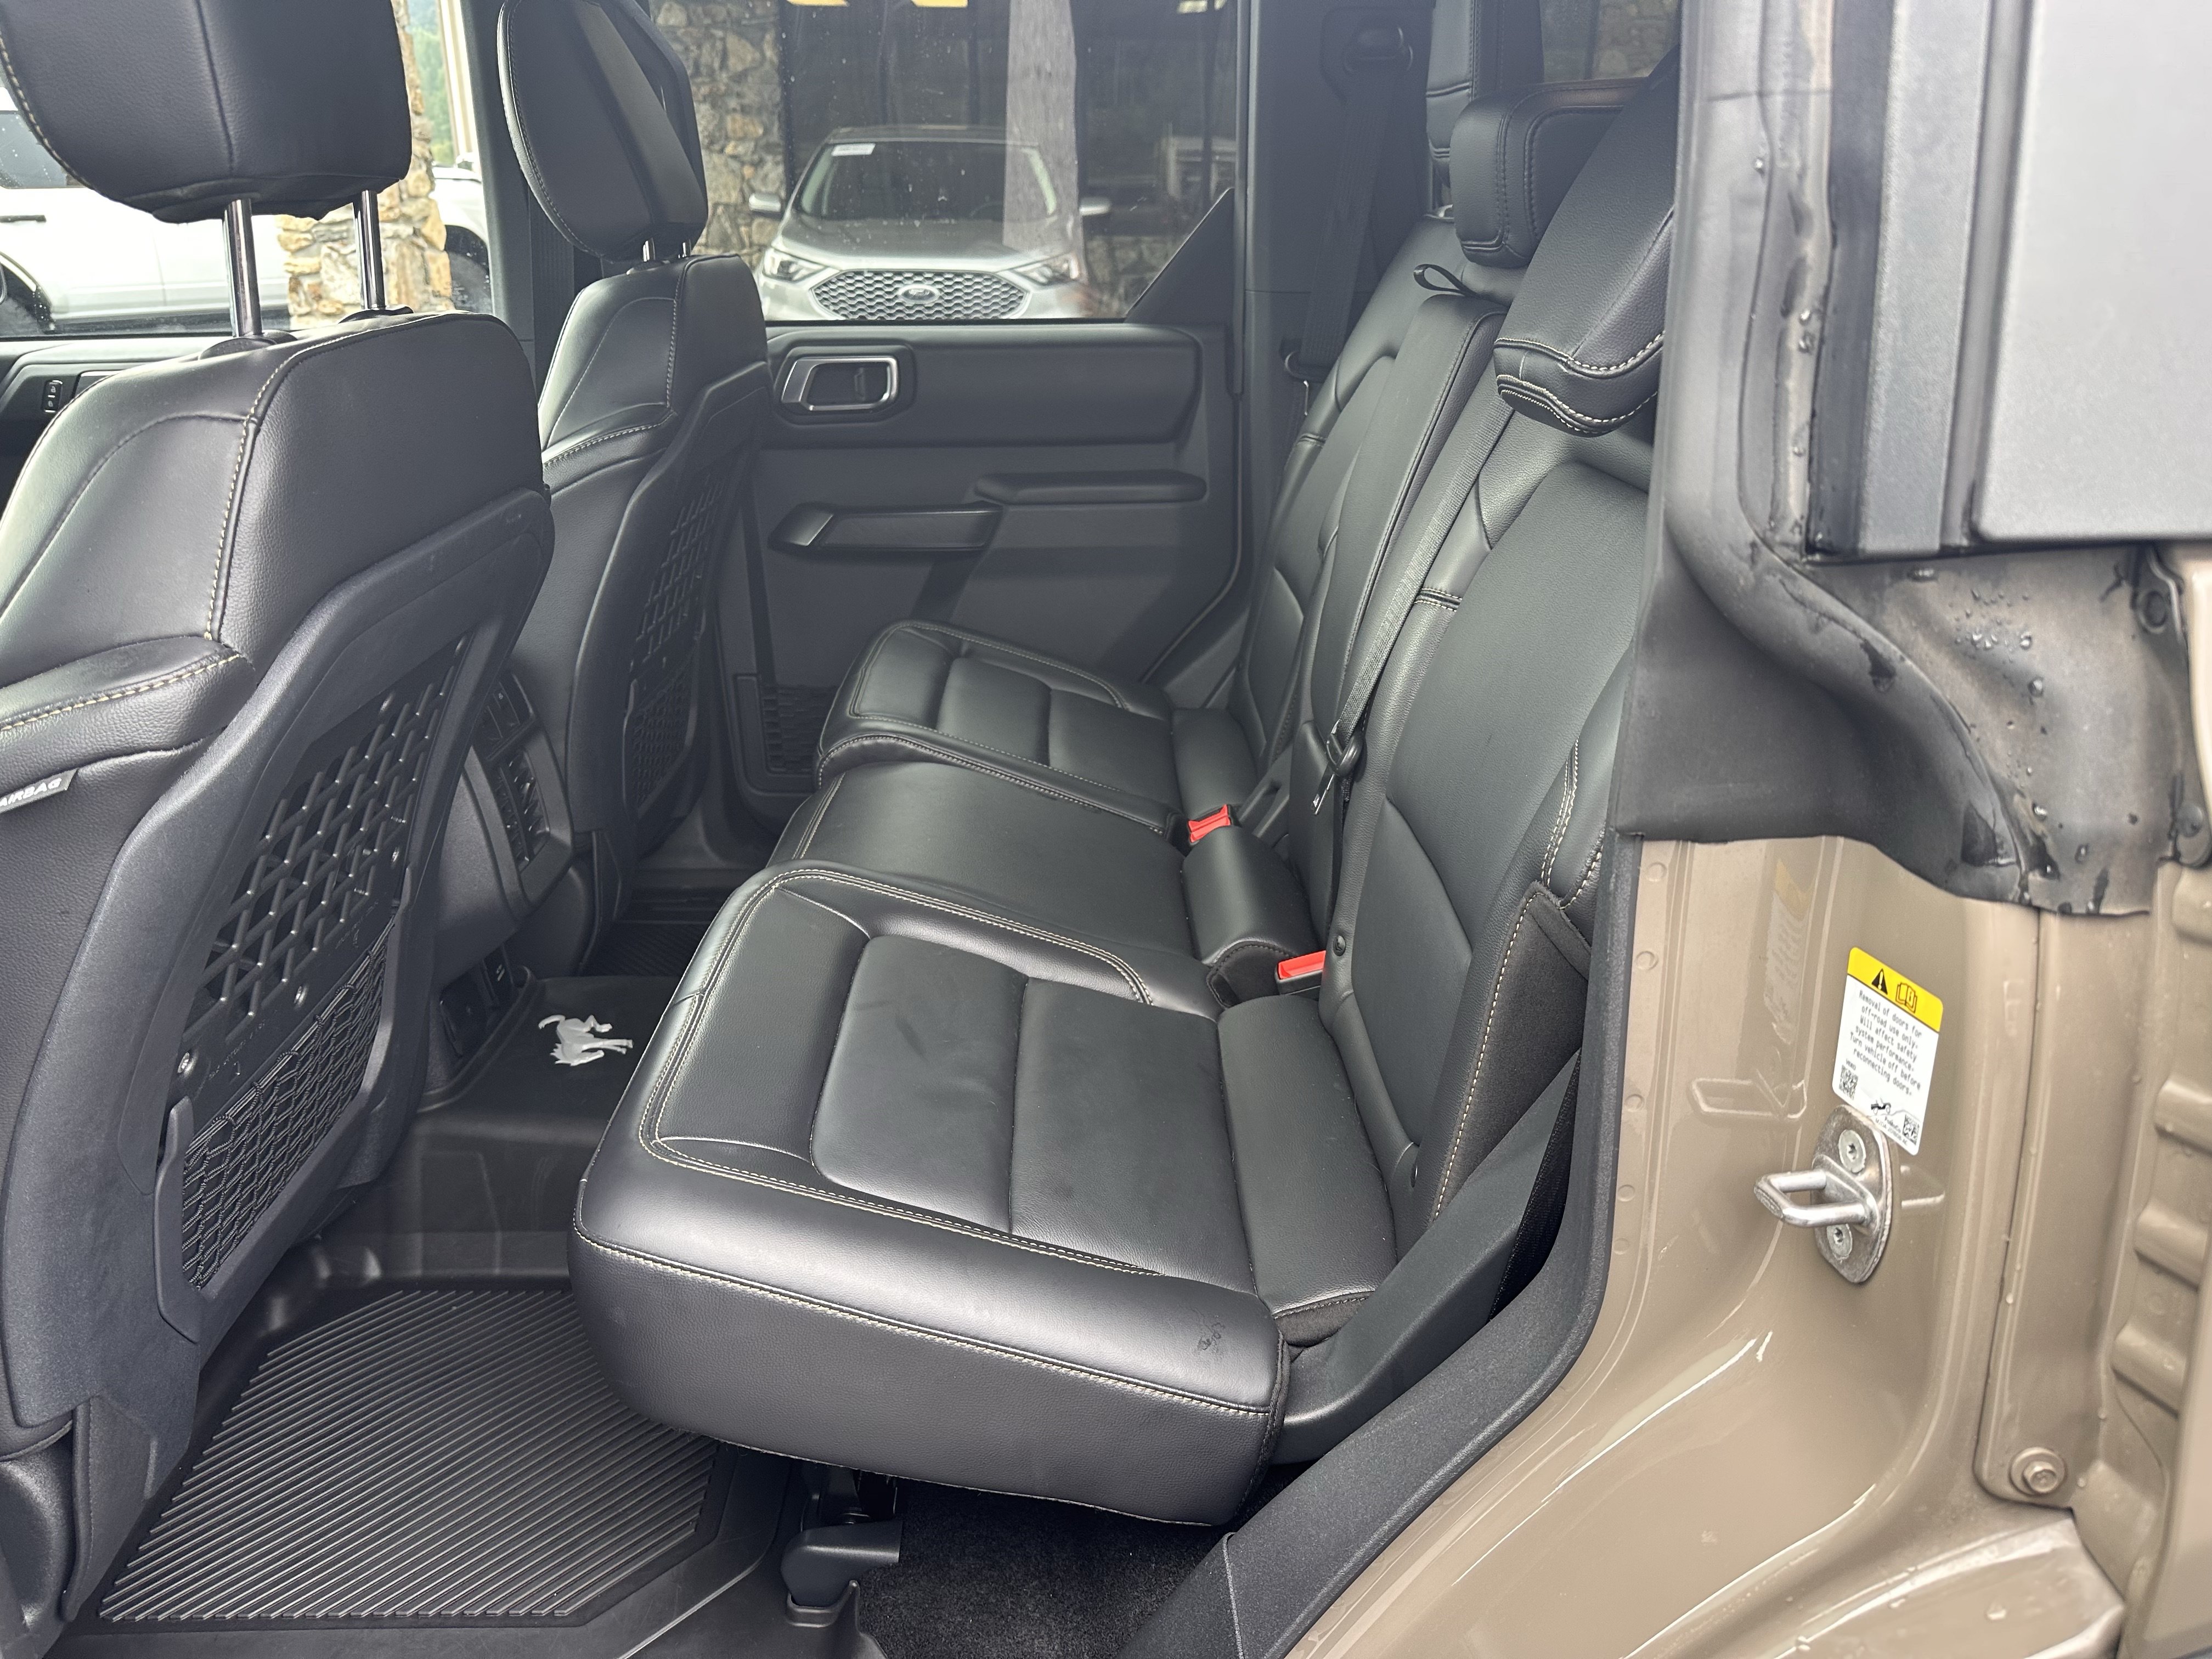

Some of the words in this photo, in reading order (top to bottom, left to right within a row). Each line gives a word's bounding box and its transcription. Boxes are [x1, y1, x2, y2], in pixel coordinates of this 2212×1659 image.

[1859, 990, 1881, 1012] Removal
[1883, 1008, 1889, 1016] of
[1892, 1013, 1909, 1030] doors
[1912, 1025, 1922, 1037] for
[1861, 1006, 1887, 1028] off-road
[1889, 1025, 1899, 1036] use
[1902, 1033, 1918, 1049] only.
[1850, 1031, 1862, 1047] Turn
[1865, 1044, 1886, 1065] vehicle
[1888, 1062, 1898, 1073] off
[1900, 1068, 1920, 1090] before
[1855, 1025, 1874, 1044] system
[1876, 1040, 1914, 1071] performance.
[1860, 1015, 1872, 1030] Will
[1875, 1028, 1894, 1045] affect
[1897, 1042, 1917, 1063] safety
[1853, 1048, 1891, 1082] reconnecting
[1893, 1077, 1912, 1096] doors.
